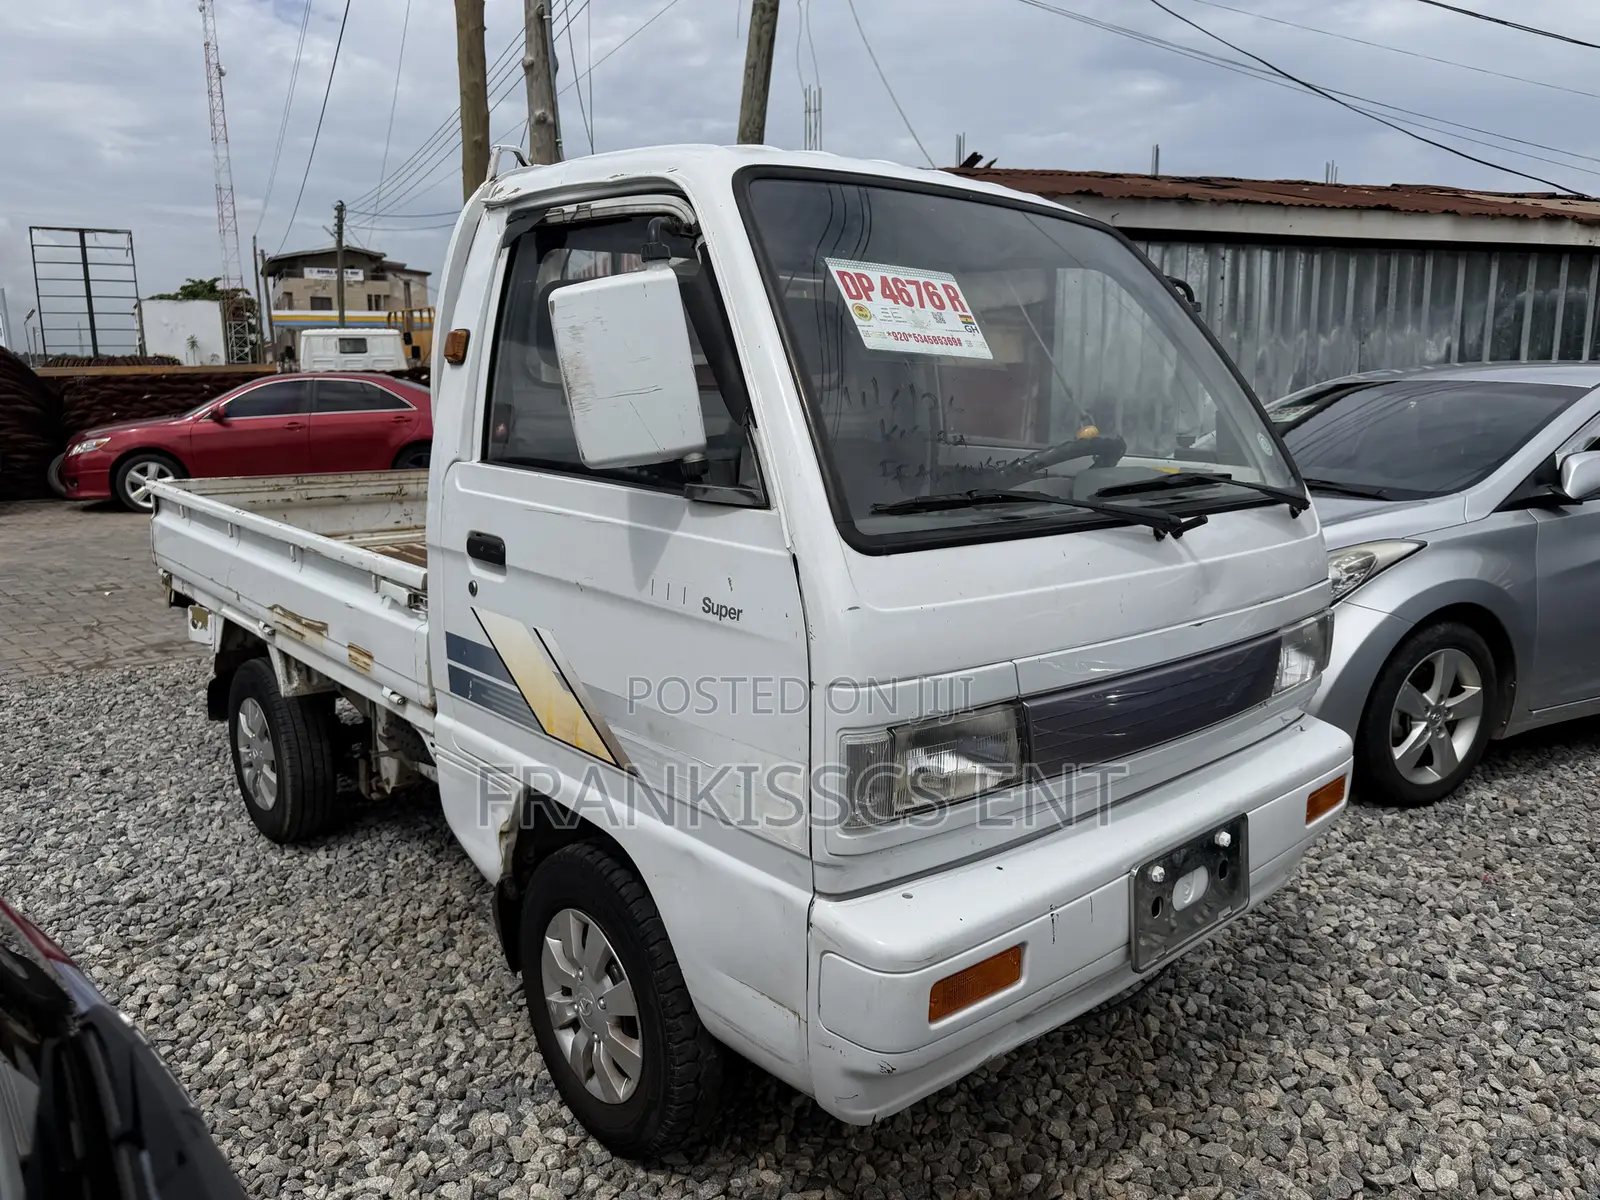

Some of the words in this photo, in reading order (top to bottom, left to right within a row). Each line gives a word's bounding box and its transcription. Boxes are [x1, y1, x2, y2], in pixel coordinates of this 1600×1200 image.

[836, 270, 875, 302] DP
[880, 276, 946, 311] 4676
[942, 284, 968, 313] R
[964, 325, 980, 334] GH
[702, 597, 743, 621] Super
